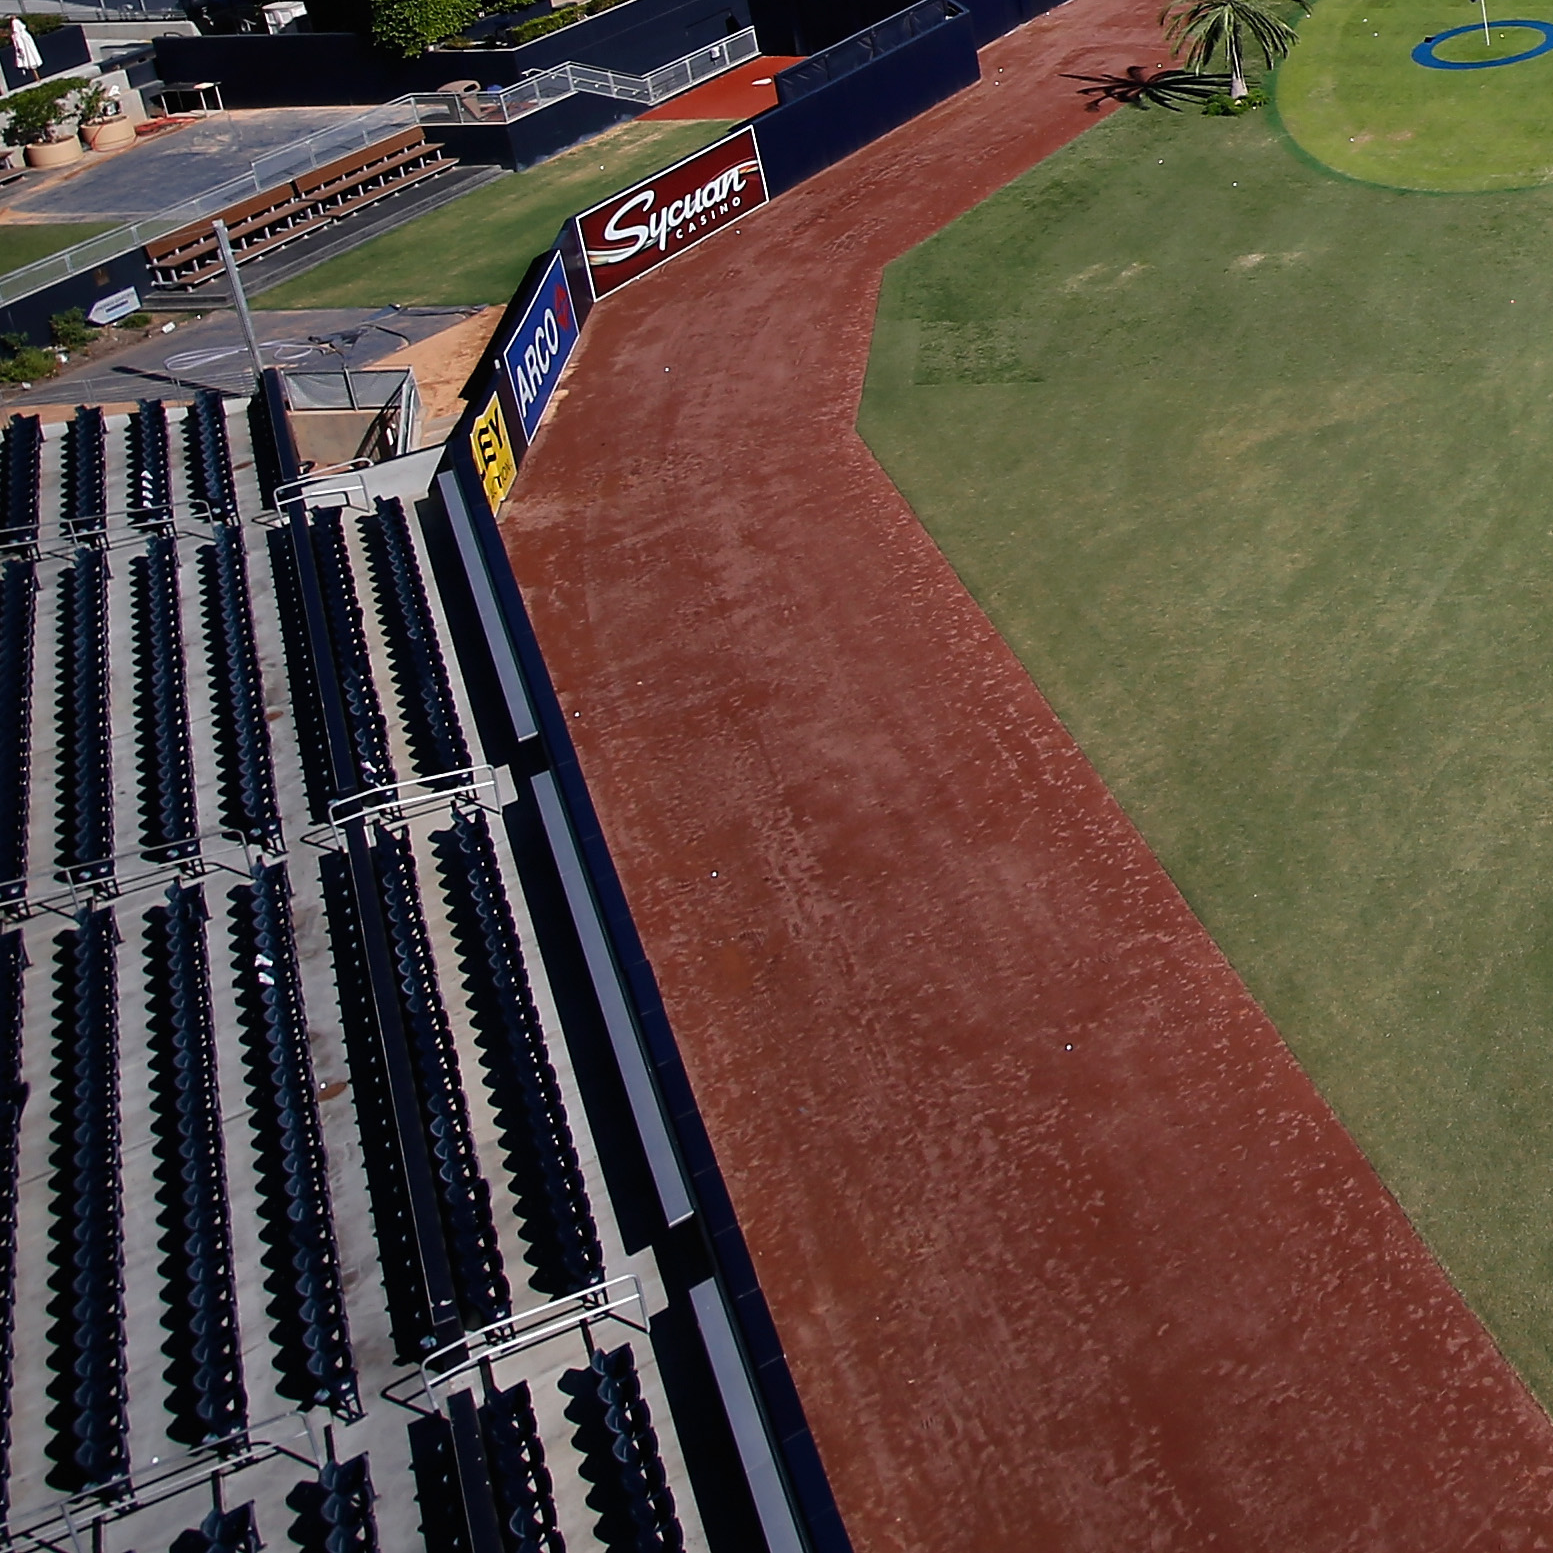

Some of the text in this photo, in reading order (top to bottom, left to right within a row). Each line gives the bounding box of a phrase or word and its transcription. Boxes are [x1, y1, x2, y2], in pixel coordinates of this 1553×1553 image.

[604, 168, 747, 263] Sycuan
[675, 196, 741, 239] CASINO
[514, 308, 561, 418] ARCO
